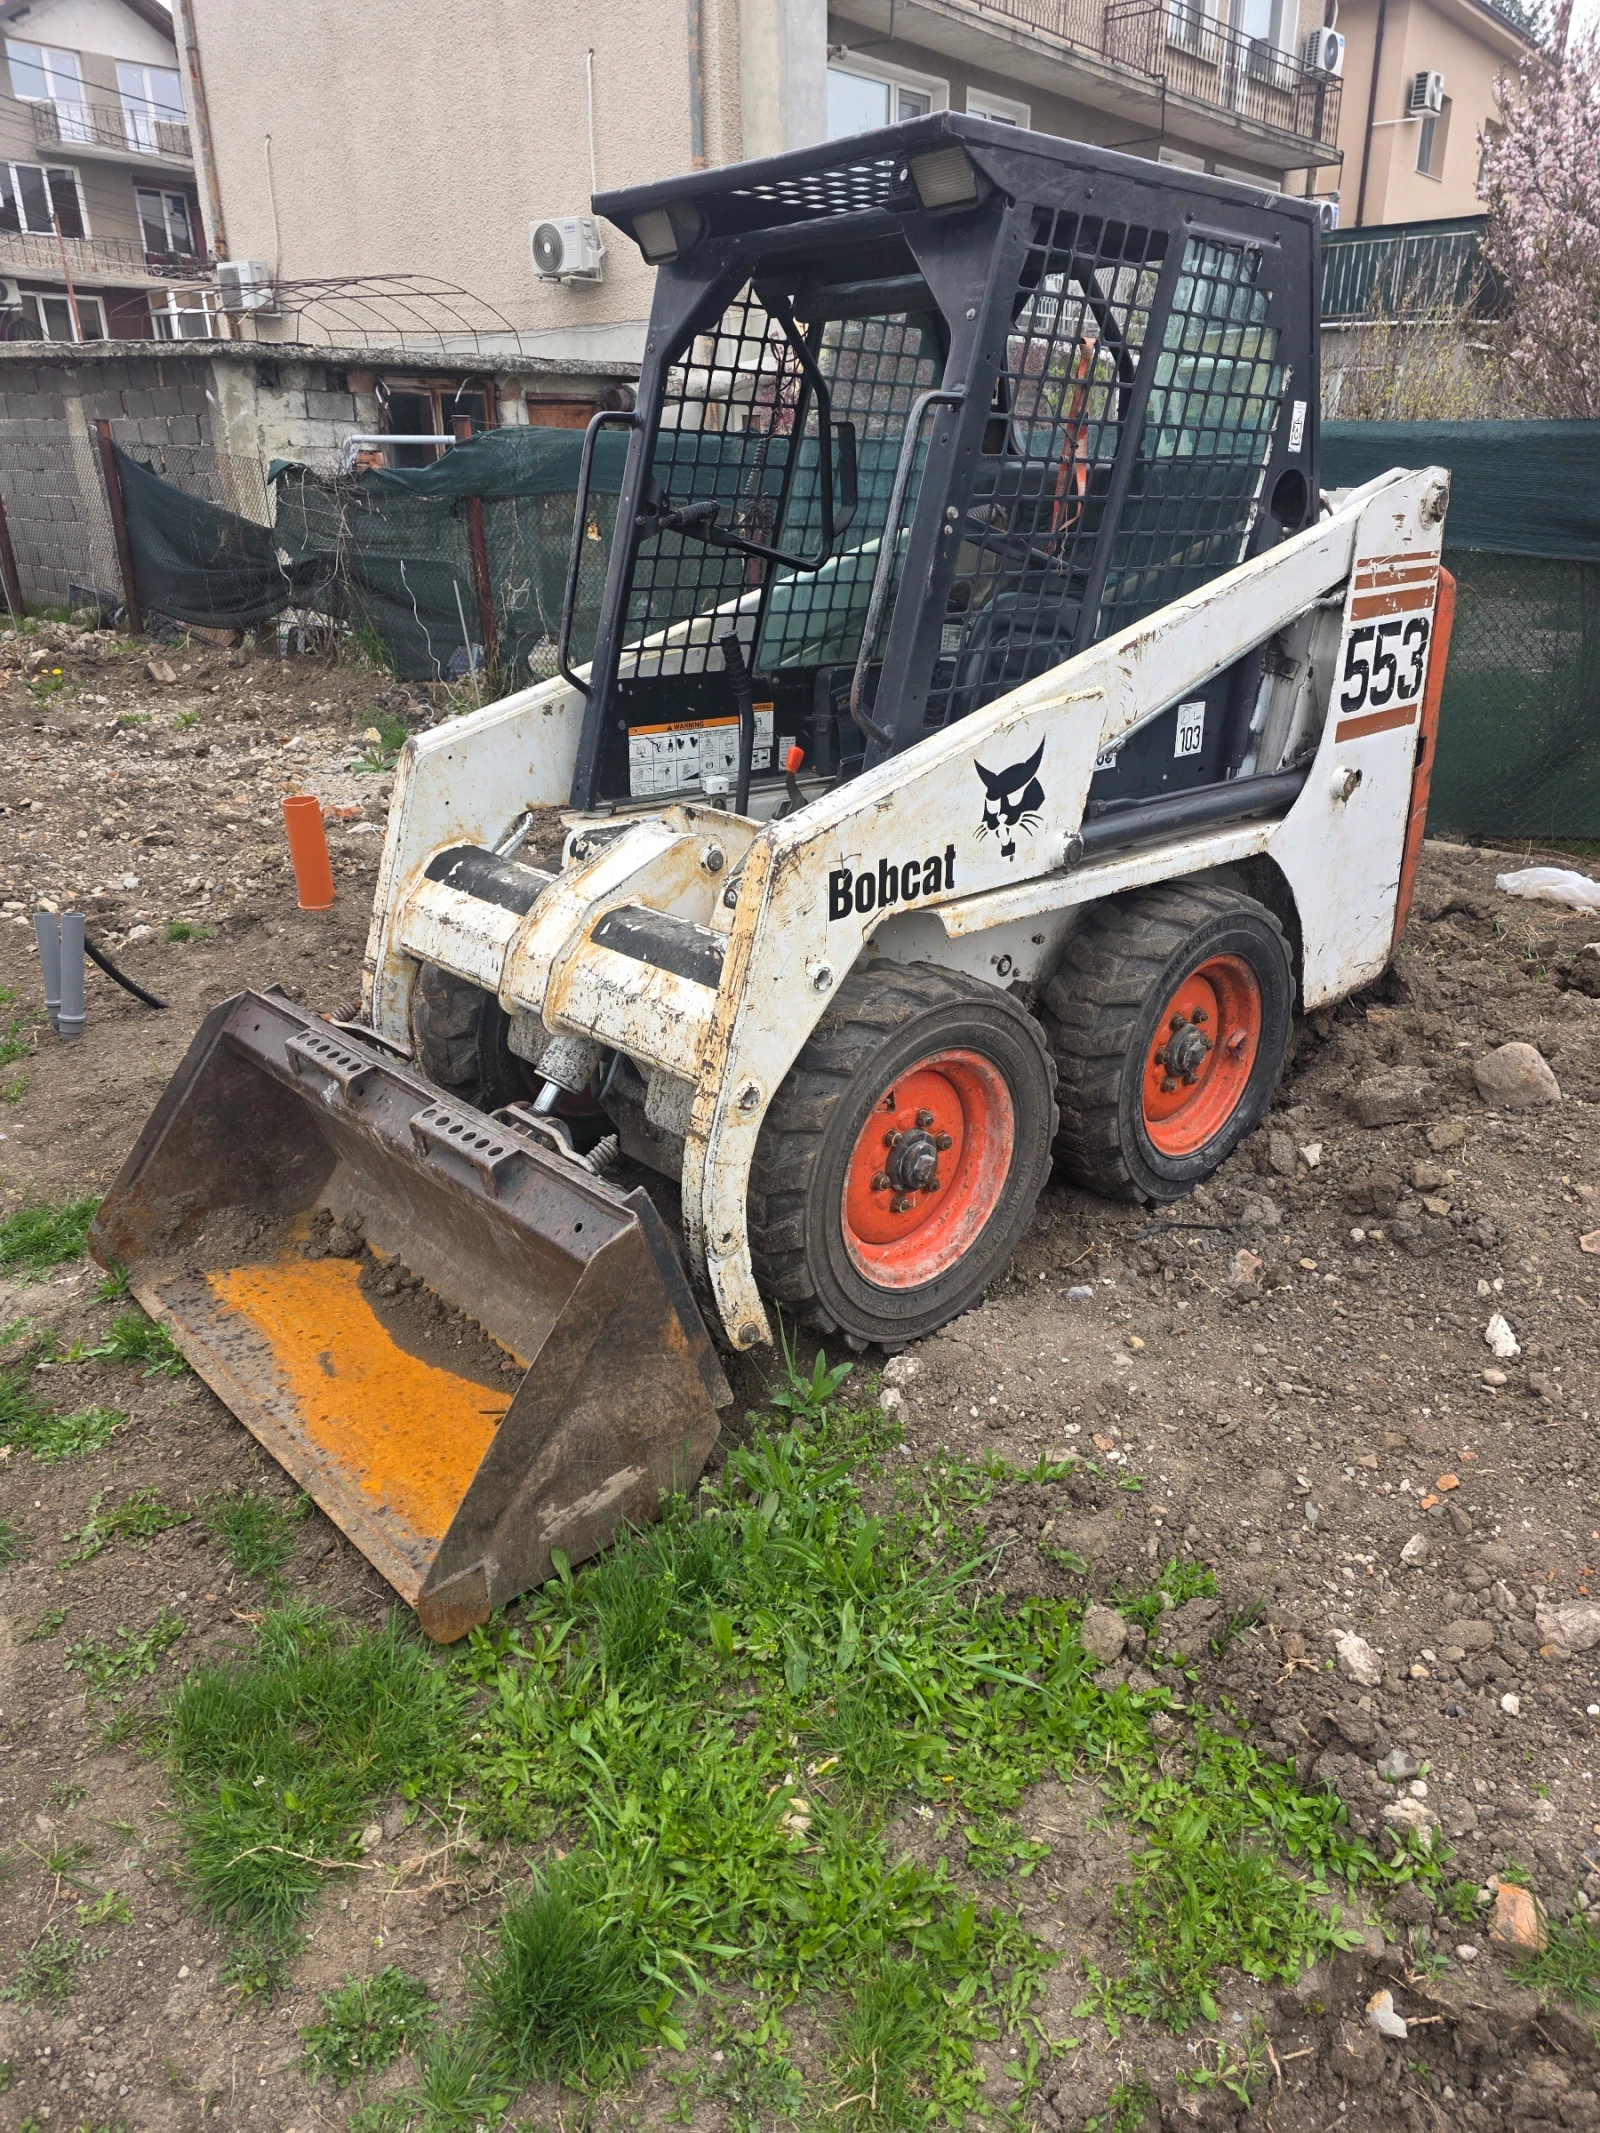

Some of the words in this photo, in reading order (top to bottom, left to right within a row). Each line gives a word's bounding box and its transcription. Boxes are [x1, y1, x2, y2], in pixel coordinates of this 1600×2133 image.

[1341, 617, 1430, 713] 553
[674, 721, 704, 730] WARNING
[1180, 725, 1201, 753] 103
[829, 844, 956, 921] Bobcat
